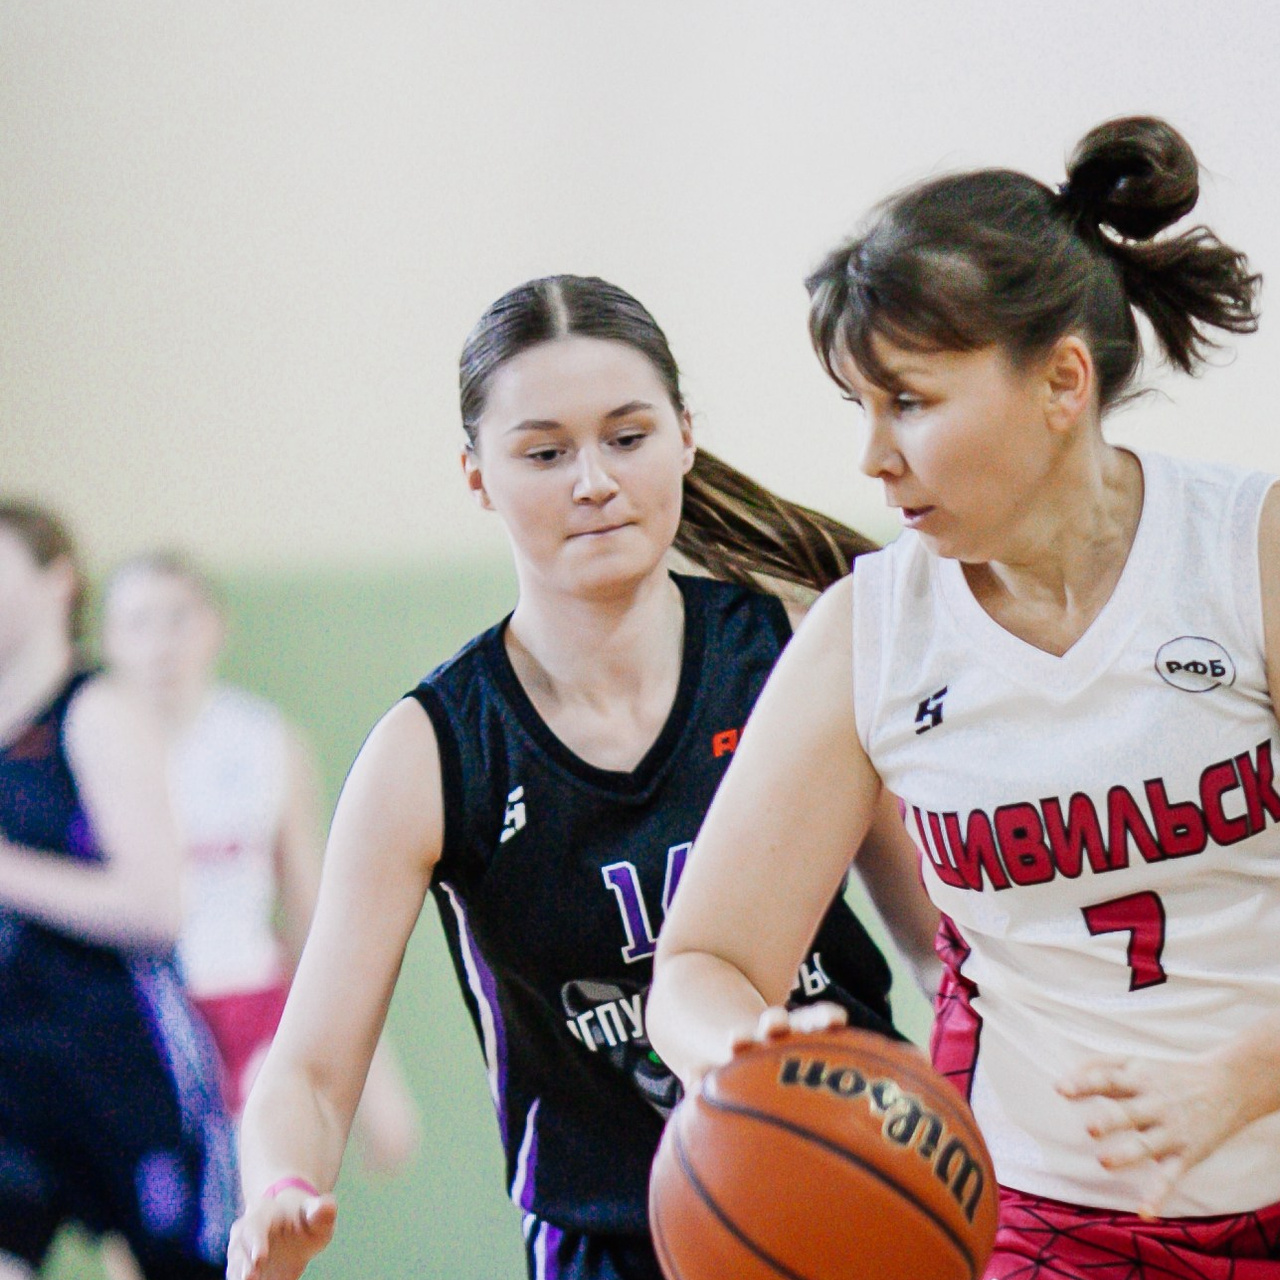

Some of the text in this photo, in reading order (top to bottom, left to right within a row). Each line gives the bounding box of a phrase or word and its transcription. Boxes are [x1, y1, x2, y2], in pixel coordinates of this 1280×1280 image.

[1165, 659, 1226, 678] РФБ
[1081, 890, 1168, 992] 7
[777, 1056, 985, 1226] Wilson
